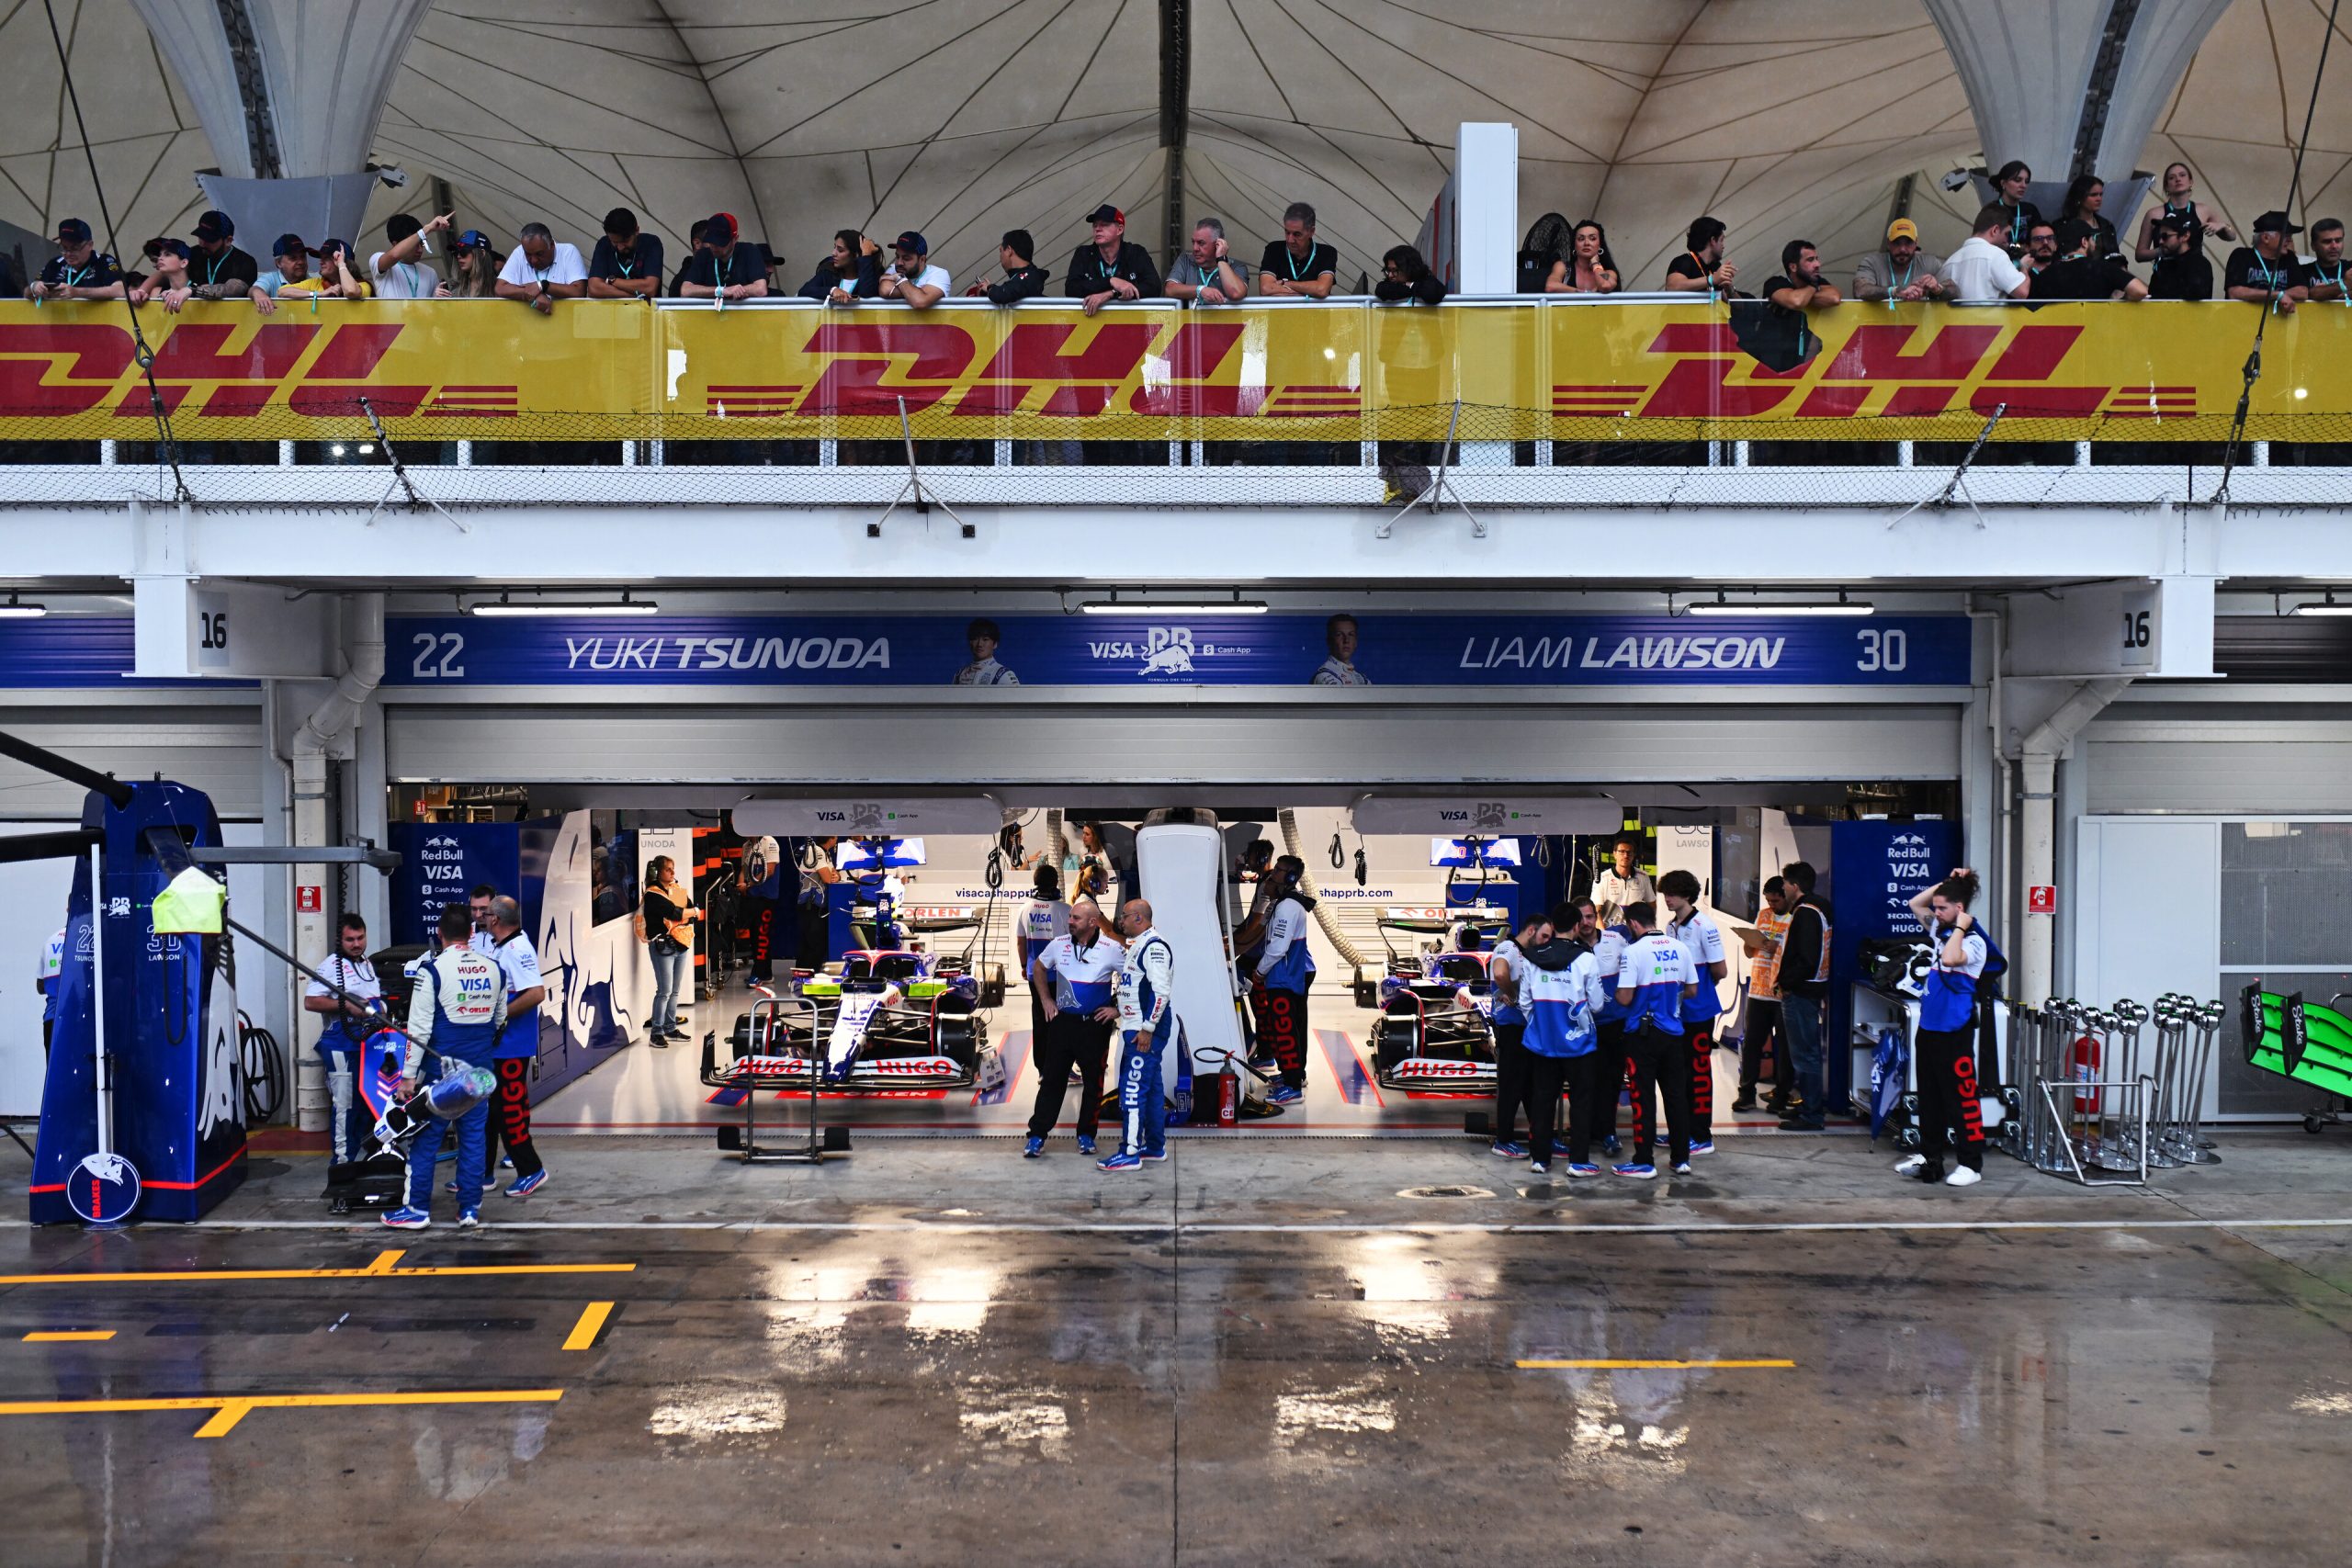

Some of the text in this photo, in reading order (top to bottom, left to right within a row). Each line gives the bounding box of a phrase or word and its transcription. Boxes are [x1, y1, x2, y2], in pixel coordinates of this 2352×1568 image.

[0, 324, 432, 417] DHL
[796, 323, 1274, 417] DHL
[1639, 323, 2111, 418] DHL
[202, 612, 227, 649] 16
[2124, 611, 2150, 648] 16
[413, 633, 464, 678] 22
[566, 637, 890, 669] YUKI TSUNODA
[1087, 642, 1135, 659] VISA
[1237, 647, 1251, 655] App
[1460, 637, 1786, 669] LIAM LAWSON
[1857, 629, 1905, 671] 30
[816, 811, 845, 821] VISA
[1440, 811, 1468, 820] VISA
[422, 850, 463, 861] Red Bull
[1888, 848, 1929, 858] Red Bull
[423, 865, 463, 879] VISA
[1888, 863, 1929, 877] VISA
[1319, 888, 1393, 898] shapprb.com
[904, 908, 960, 917] ORLEN
[1029, 913, 1052, 923] VISA
[757, 909, 773, 960] HUGO
[1892, 924, 1924, 932] HUGO
[1653, 950, 1679, 962] VISA
[458, 965, 487, 975] HUGO
[458, 978, 492, 991] VISA
[1120, 973, 1132, 987] SA
[2251, 994, 2262, 1033] Stake
[2292, 1005, 2304, 1044] Stake
[1272, 997, 1300, 1070] HUGO
[737, 1059, 804, 1074] HUGO
[876, 1059, 952, 1074] HUGO
[1401, 1062, 1477, 1077] HUGO
[1692, 1032, 1712, 1115] HUGO
[1125, 1055, 1144, 1106] HUGO
[501, 1058, 528, 1146] HUGO
[1954, 1055, 1984, 1141] HUGO
[92, 1179, 101, 1218] BRAKES
